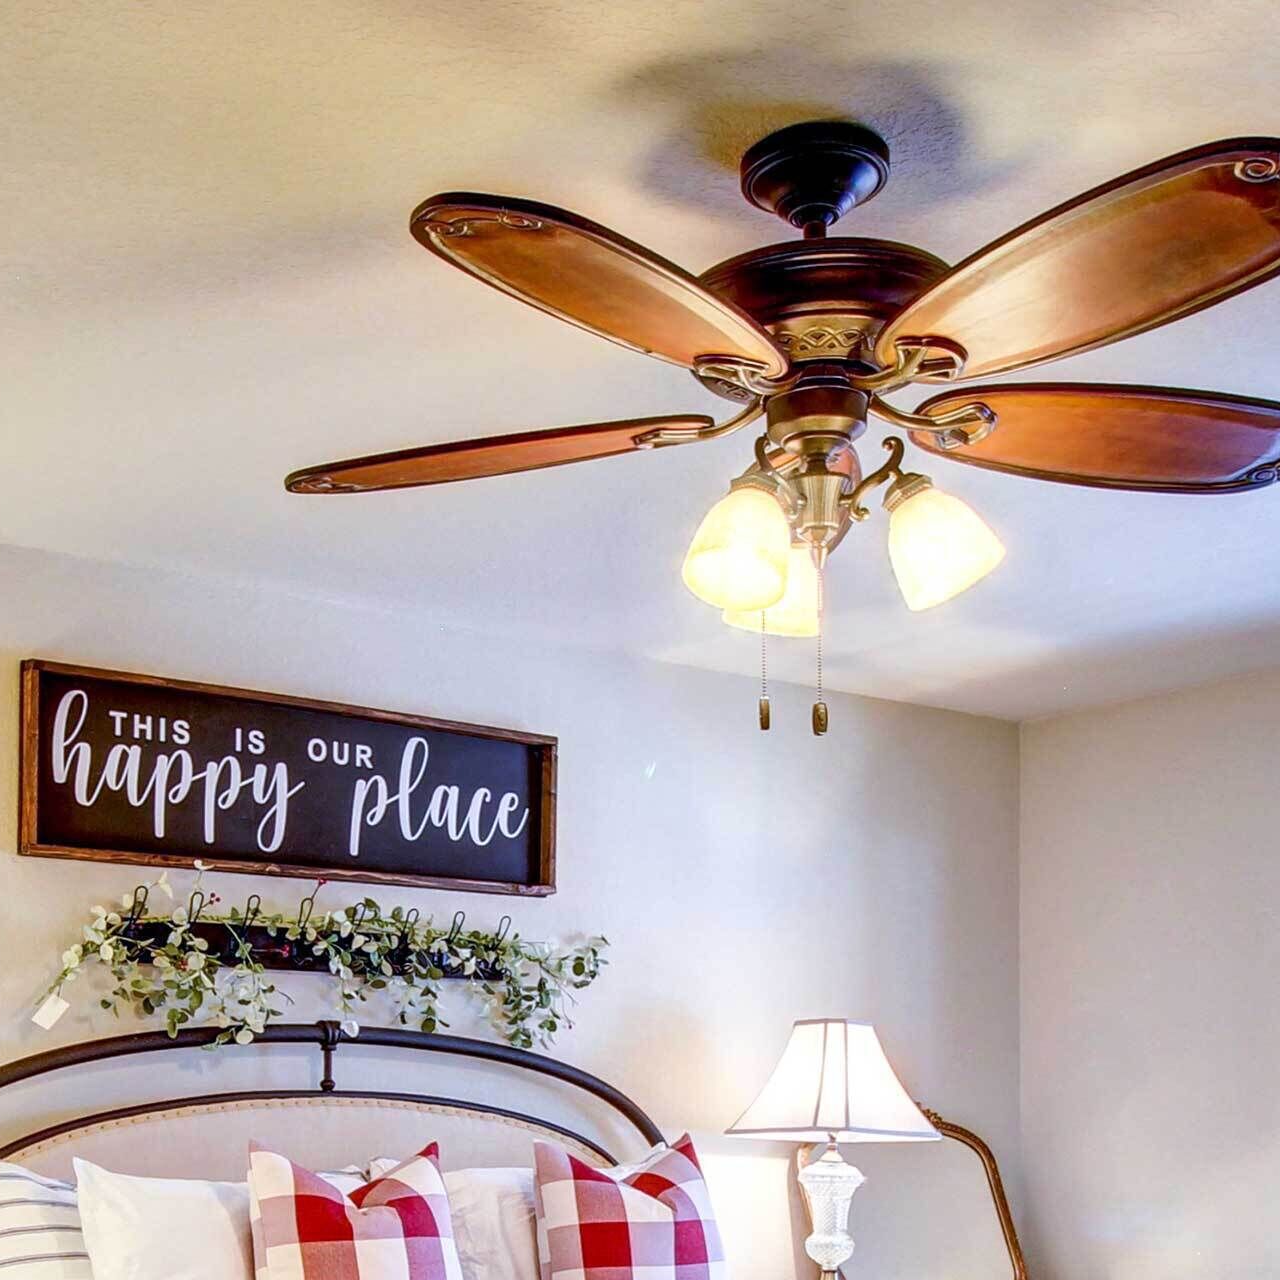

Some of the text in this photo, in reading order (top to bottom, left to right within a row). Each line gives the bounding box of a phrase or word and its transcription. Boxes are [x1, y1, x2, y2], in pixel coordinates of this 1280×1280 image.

[52, 689, 530, 857] happy place
[108, 710, 374, 769] THIS IS OUR
